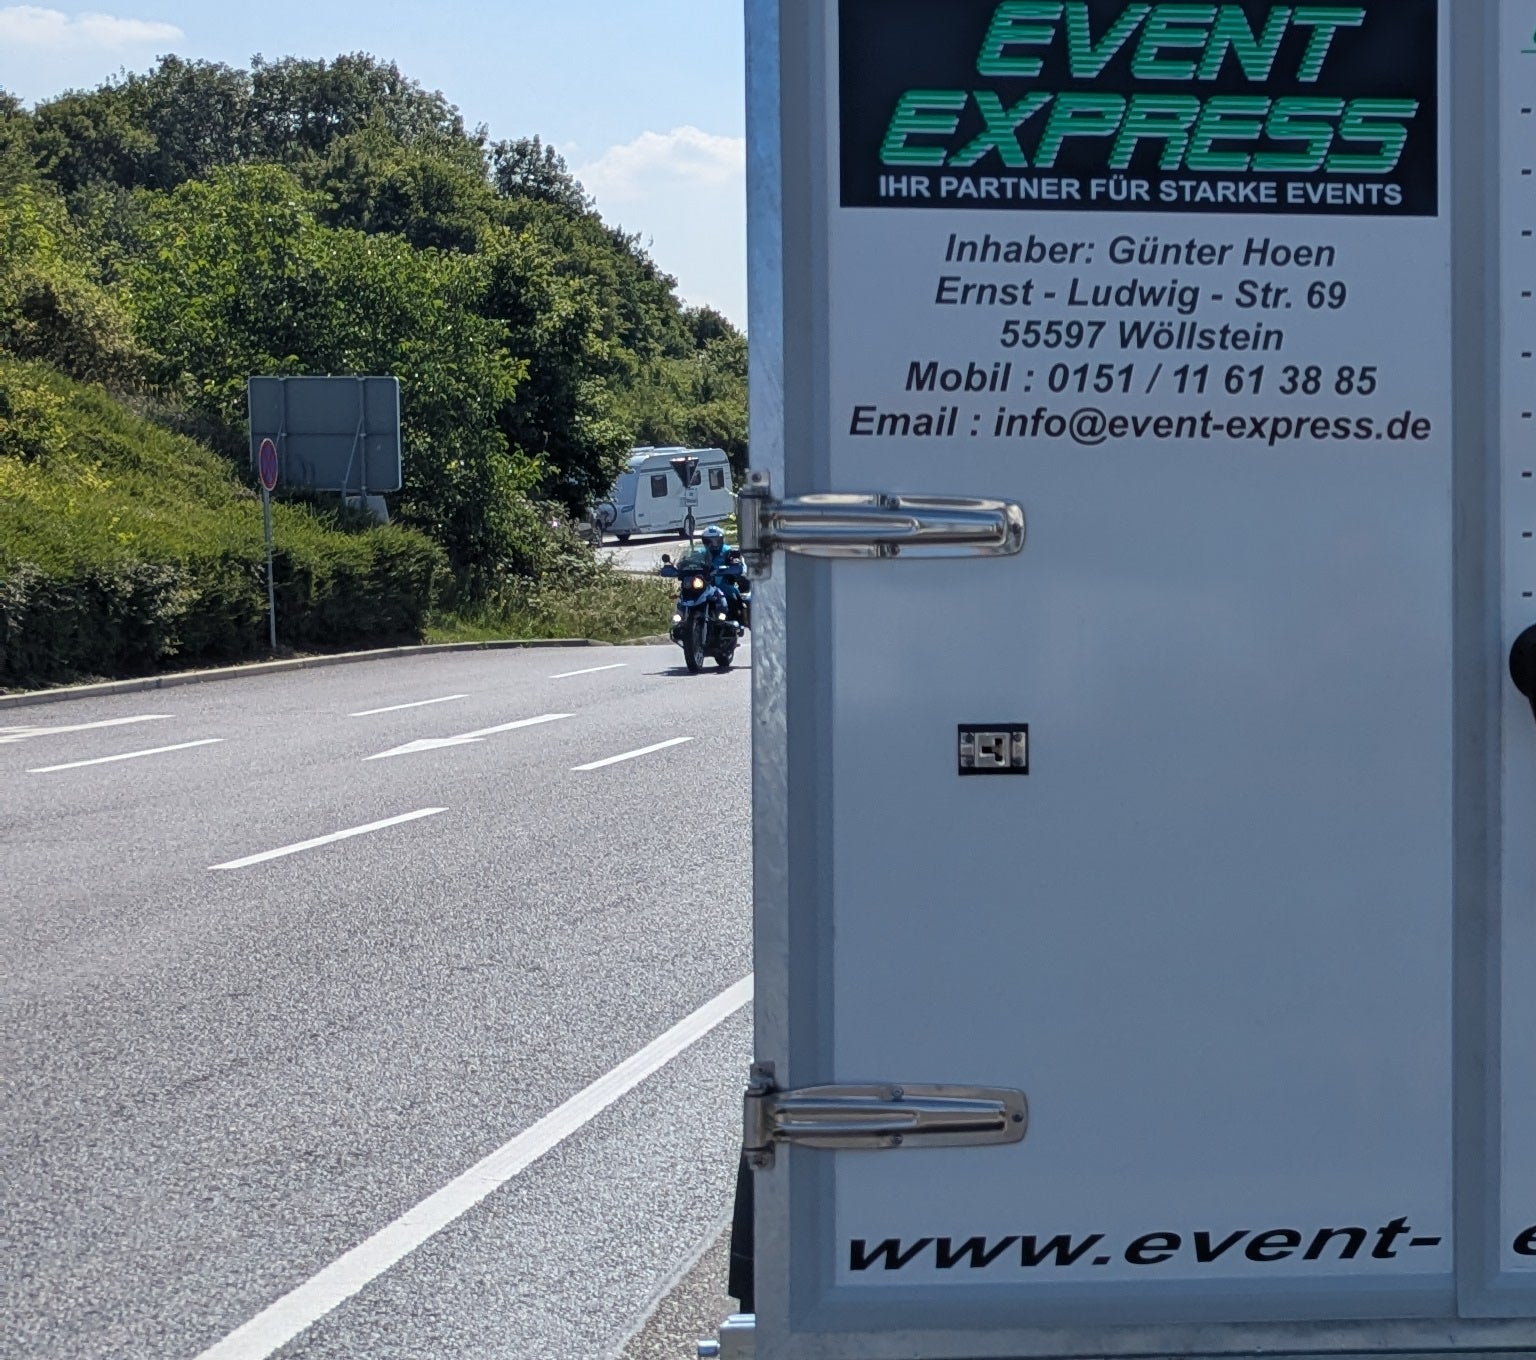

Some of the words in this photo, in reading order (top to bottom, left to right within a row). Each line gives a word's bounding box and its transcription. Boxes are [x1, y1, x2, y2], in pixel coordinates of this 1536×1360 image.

[977, 0, 1367, 83] EVENT
[879, 90, 1420, 174] EXPRESS
[880, 175, 930, 197] IHR
[941, 177, 1080, 199] PARTNER
[1091, 174, 1150, 201] FÜR
[1160, 180, 1277, 202] STARKE
[1287, 182, 1402, 205] EVENTS
[946, 234, 1094, 263] Inhaber:
[1109, 236, 1233, 265] Günter
[1243, 238, 1335, 266] Hoen
[935, 276, 1034, 305] Ernst
[1068, 278, 1199, 315] Ludwig
[1236, 280, 1291, 308] Str.
[1308, 281, 1346, 309] 69
[1001, 320, 1106, 348] 55597
[1120, 321, 1283, 350] Wöllstein
[906, 362, 1011, 391] Mobil
[1049, 363, 1133, 393] 0151
[1174, 364, 1208, 393] 11
[1225, 365, 1264, 394] 61
[1279, 366, 1321, 395] 38
[1335, 366, 1377, 395] 85
[850, 406, 958, 436] Email
[995, 407, 1430, 446] info@event-express.de
[846, 1215, 1443, 1272] www.event-
